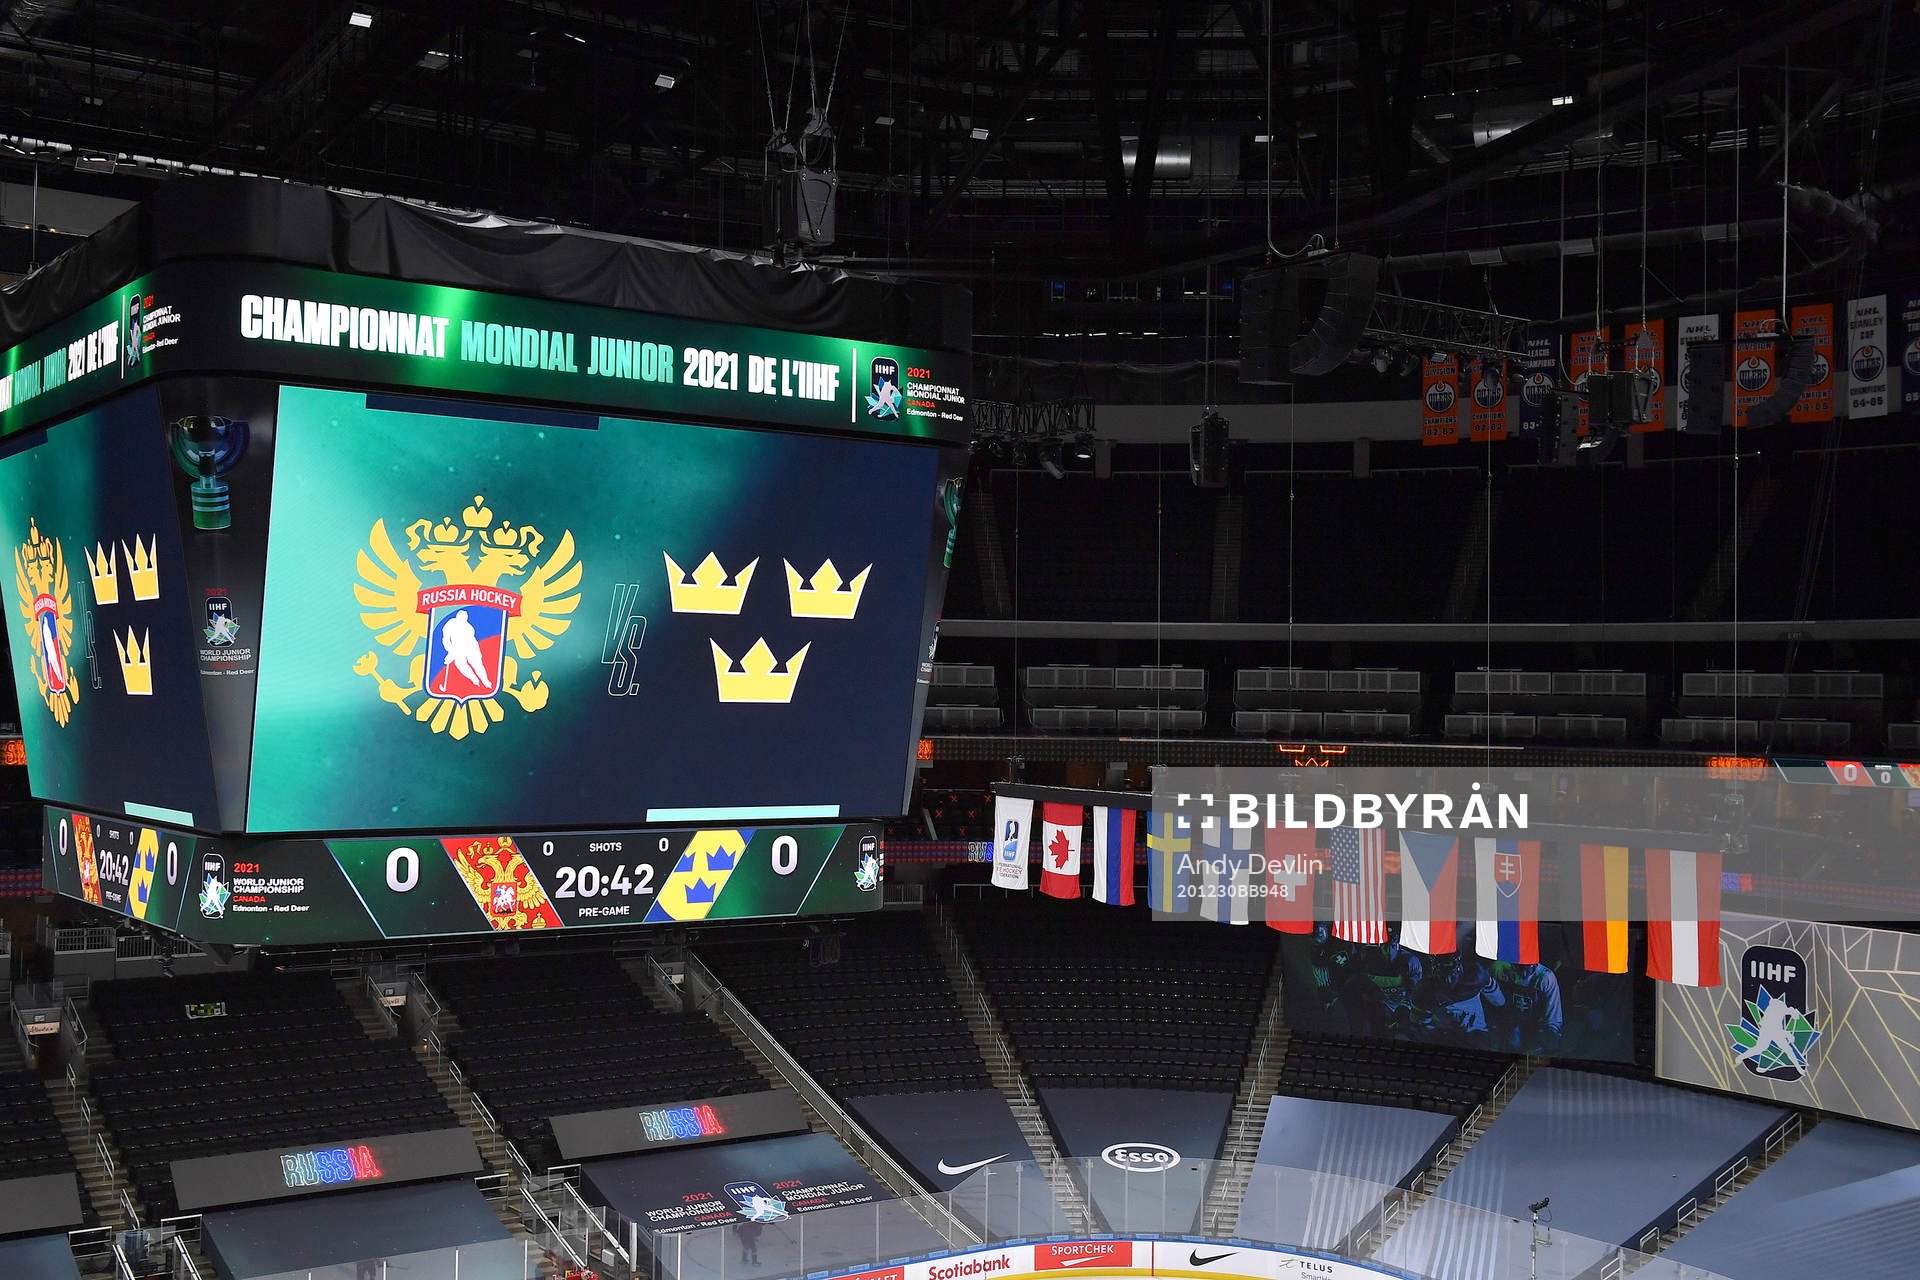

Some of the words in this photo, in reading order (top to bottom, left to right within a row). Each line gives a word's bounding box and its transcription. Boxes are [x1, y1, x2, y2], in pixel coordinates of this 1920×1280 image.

[240, 294, 449, 358] CHAMPIONNAT
[461, 320, 578, 373] MONDIAL
[587, 336, 674, 383] JUNIOR
[683, 348, 739, 391] 2021
[748, 355, 777, 395] DE
[782, 358, 840, 402] L'IIHF
[875, 364, 895, 374] IIHF
[907, 367, 931, 379] 2021
[906, 382, 960, 395] CHAMPIONNAT
[906, 390, 941, 401] MONDIAL
[943, 395, 965, 404] JUNIOR
[906, 399, 936, 408] CANADA
[906, 408, 937, 418] Edmonton
[422, 589, 467, 606] RUSSIA
[470, 588, 517, 608] HOCKEY
[209, 603, 227, 611] IIHF
[222, 648, 251, 656] JUNIOR
[1844, 764, 1857, 782] 0
[1880, 771, 1891, 784] 0
[60, 818, 67, 855] 0
[543, 841, 554, 856] 0
[589, 842, 622, 852] SHOTS
[658, 837, 669, 852] 0
[770, 835, 798, 875] 0
[100, 849, 128, 886] 20:42
[167, 842, 177, 885] 0
[204, 861, 220, 872] IIHF
[233, 863, 260, 873] 2021
[386, 847, 419, 892] 0
[233, 878, 265, 886] WORLD
[267, 878, 304, 886] JUNIOR
[555, 863, 654, 898] 20:42
[233, 885, 304, 893] CHAMPIONSHIP
[579, 905, 630, 917] PRE-GAME
[1750, 960, 1797, 983] IIHF
[639, 1104, 724, 1141] RUSSIA
[280, 1144, 381, 1188] RUSSIA
[731, 1185, 757, 1195] IIHF
[773, 1179, 804, 1189] 2021
[781, 1181, 849, 1197] CHAMPIONNAT
[683, 1192, 714, 1203] 2021
[785, 1190, 830, 1202] MONDIAL
[830, 1183, 866, 1195] JUNIOR
[645, 1206, 683, 1217] WORLD
[685, 1200, 723, 1211] JUNIOR
[791, 1197, 828, 1207] CANADA
[797, 1202, 835, 1212] Edmonton
[839, 1198, 855, 1206] Red
[855, 1195, 873, 1203] Deer
[650, 1205, 726, 1222] CHAMPIONSHIP
[694, 1211, 733, 1222] CANADA
[1051, 1243, 1114, 1256] SPORTCHEK
[929, 1254, 1011, 1280] Scotiabank
[1300, 1261, 1333, 1273] TELUS
